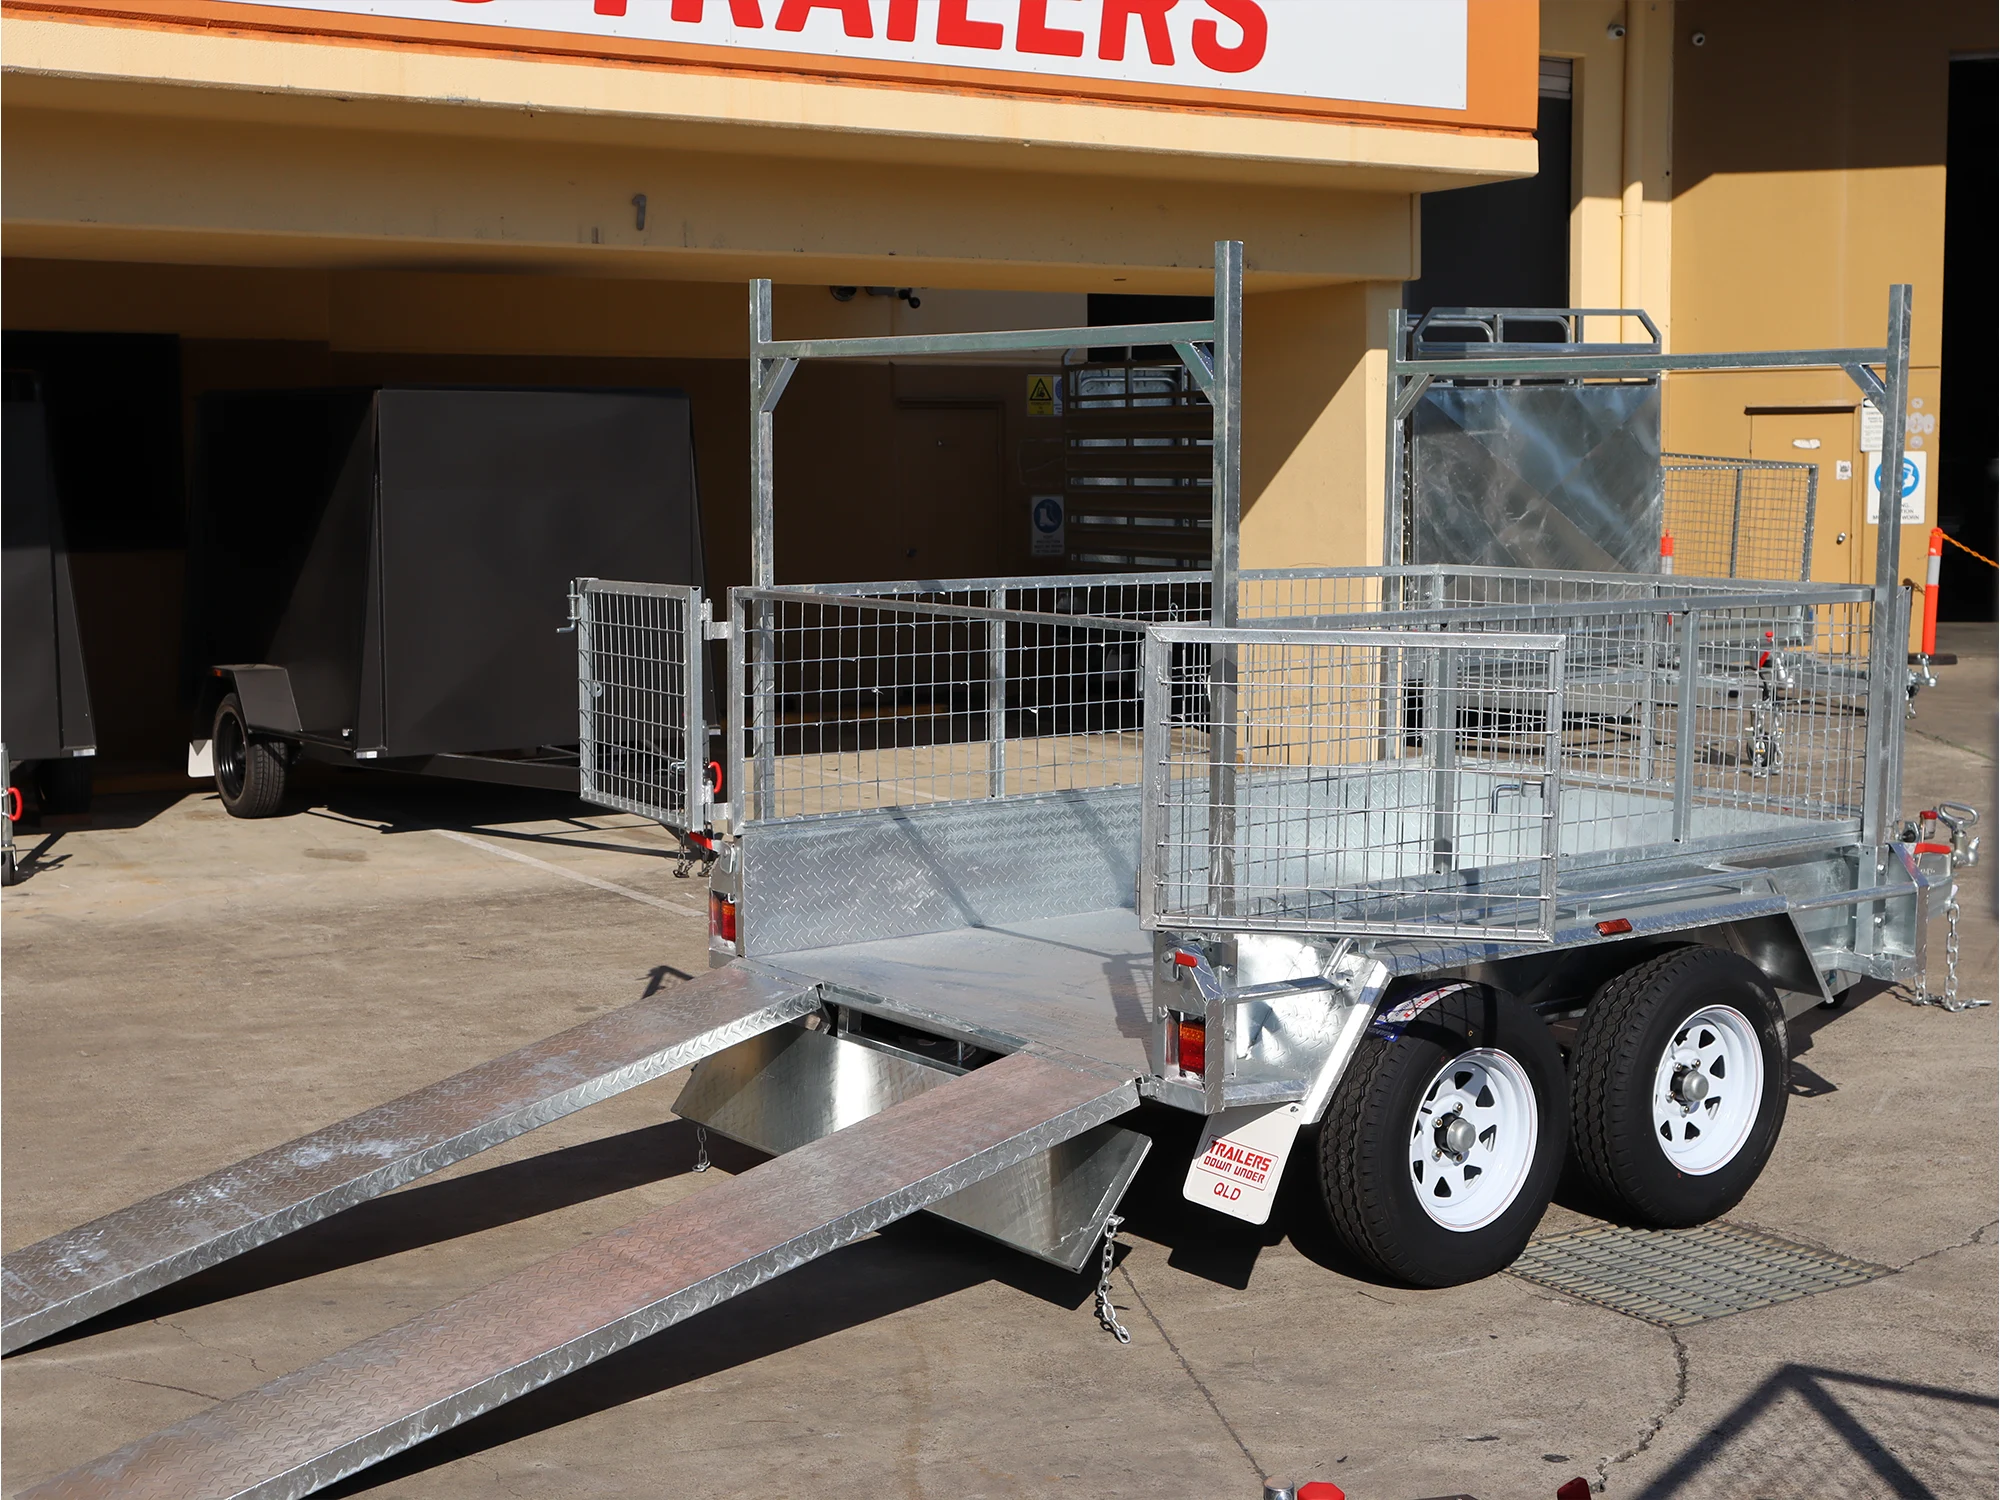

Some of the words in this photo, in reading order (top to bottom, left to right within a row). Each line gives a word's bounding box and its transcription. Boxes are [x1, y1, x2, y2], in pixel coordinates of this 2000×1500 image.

[594, 0, 1268, 73] LERS
[631, 193, 647, 231] 1
[1203, 1155, 1232, 1172] DOWN
[1233, 1166, 1266, 1184] UNDER
[1209, 1140, 1272, 1172] TRAILERS
[1213, 1182, 1241, 1201] QLD
